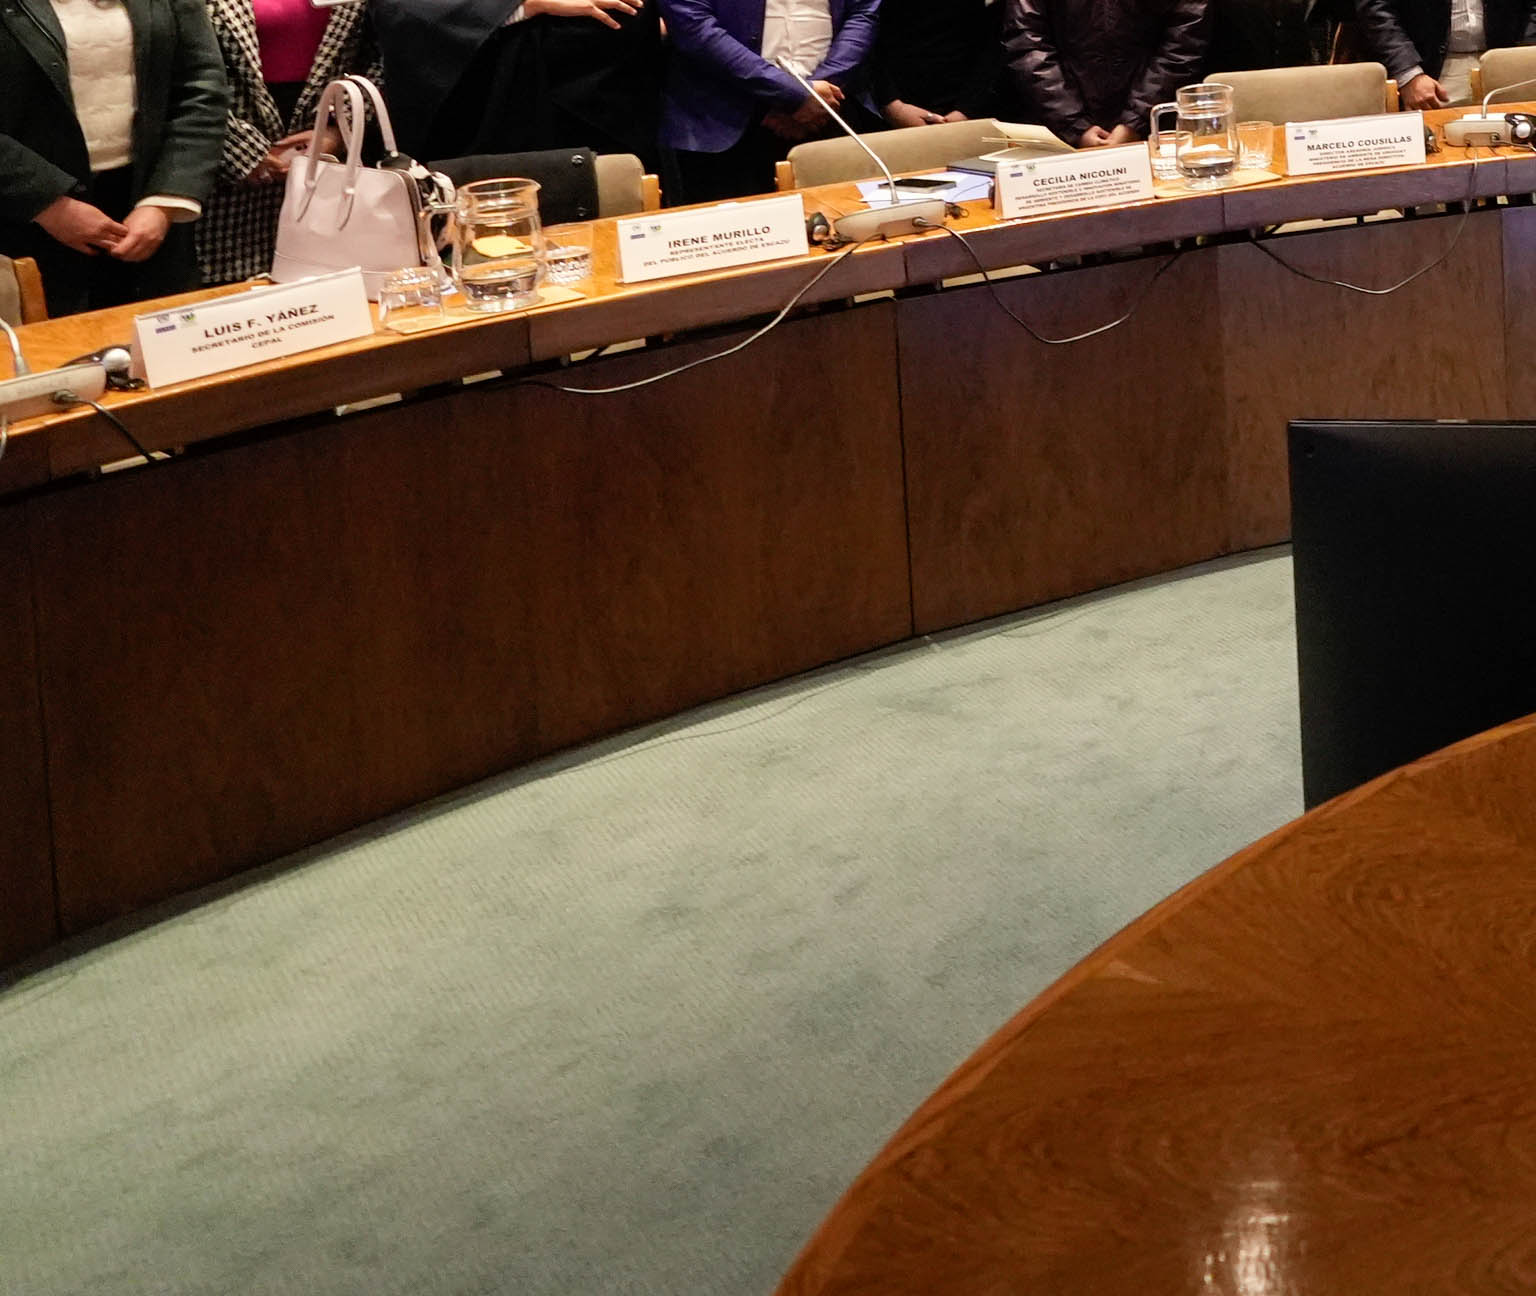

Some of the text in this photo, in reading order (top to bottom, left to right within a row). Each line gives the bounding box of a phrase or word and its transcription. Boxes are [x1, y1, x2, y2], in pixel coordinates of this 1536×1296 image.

[1307, 136, 1412, 151] MARCELO COUSILLAS
[1033, 168, 1127, 186] CECILIA NICOLINI
[668, 227, 771, 248] IRENE MURILLO
[204, 322, 242, 339] LUIS
[247, 317, 262, 329] F.
